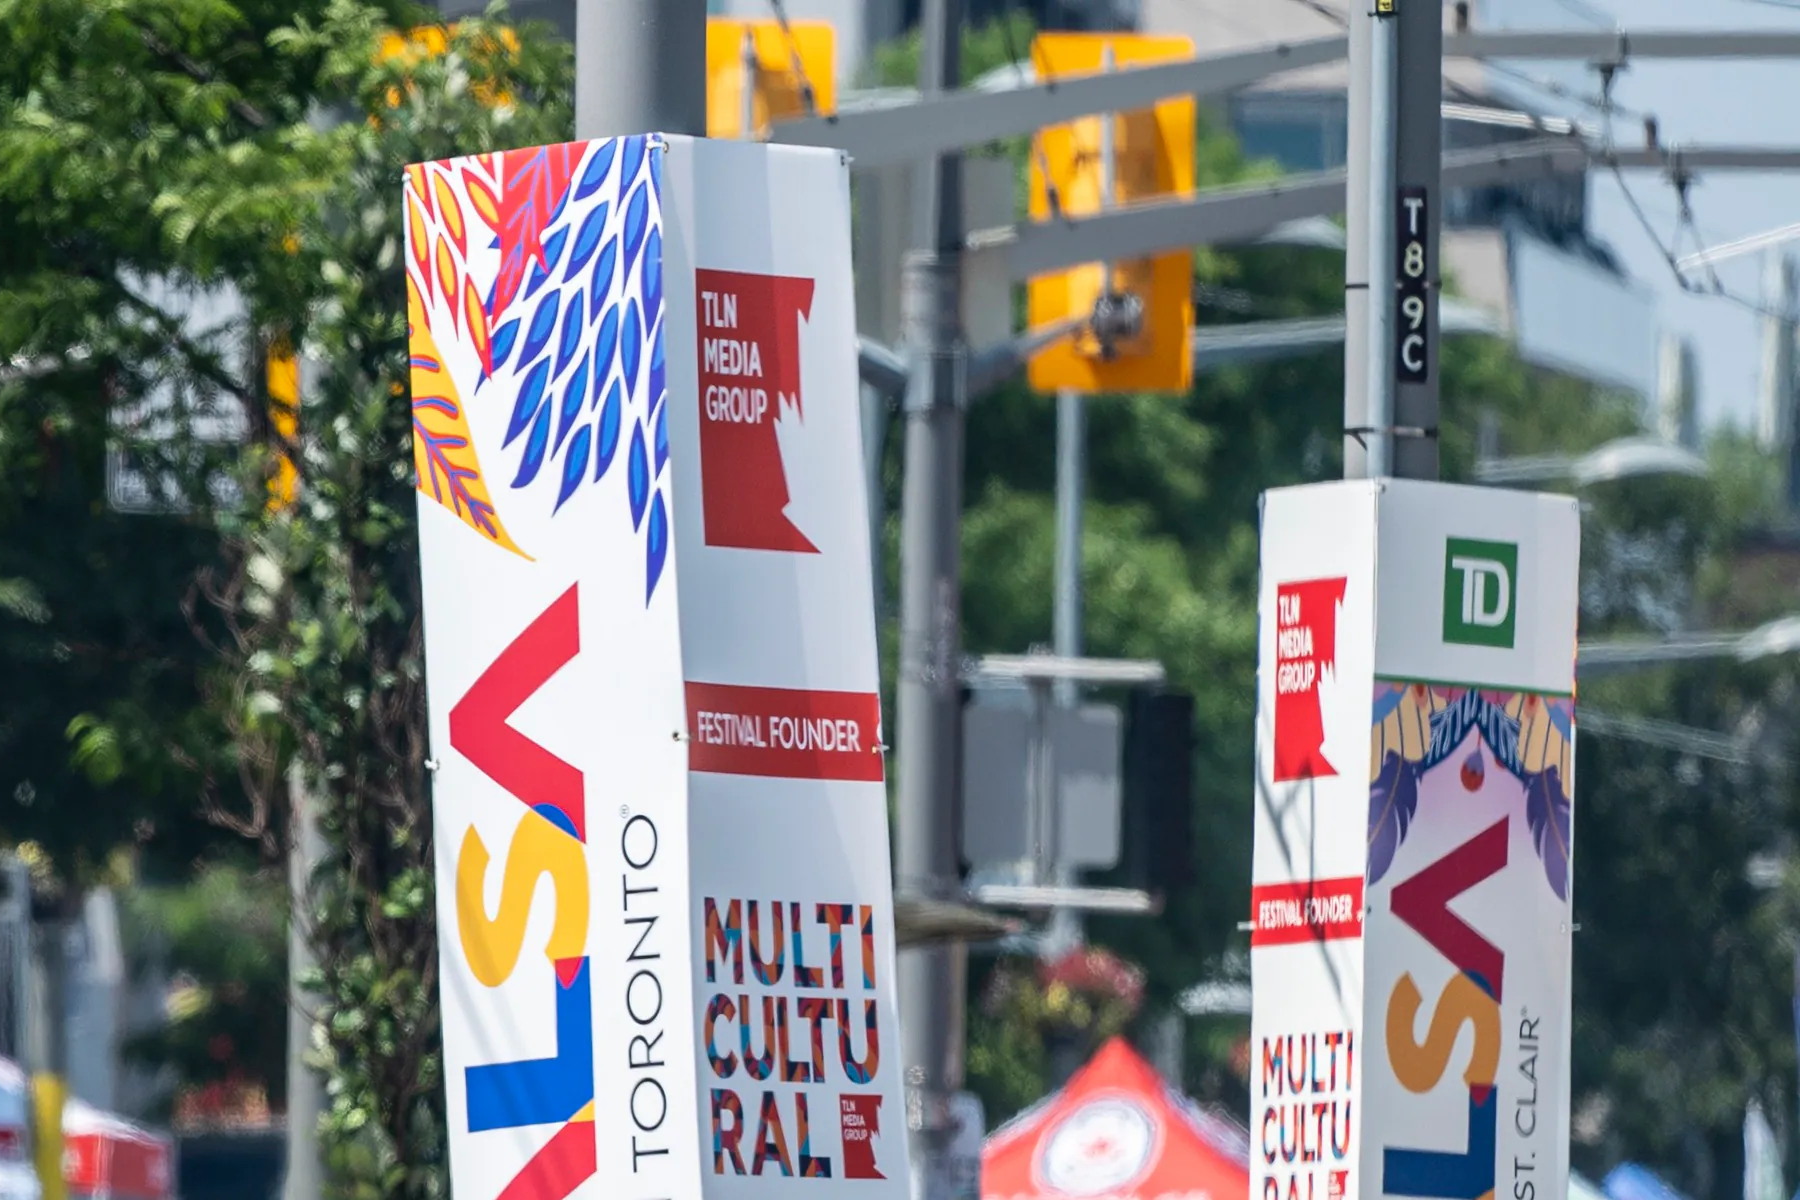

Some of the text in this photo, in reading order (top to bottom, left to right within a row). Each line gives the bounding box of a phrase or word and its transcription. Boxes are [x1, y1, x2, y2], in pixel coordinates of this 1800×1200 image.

[701, 290, 738, 329] TLN
[703, 337, 763, 378] MEDIA
[705, 384, 768, 424] GROUP
[1278, 593, 1301, 626] TLN
[1451, 554, 1511, 628] TD
[1278, 625, 1314, 660] MEDIA
[1277, 660, 1316, 694] GROUP
[697, 711, 862, 752] FESTIVAL FOUNDER
[1258, 893, 1353, 930] FESTIVAL FOUNDER
[703, 896, 877, 990] MULTI
[703, 992, 881, 1085] CULTU
[1262, 1028, 1354, 1098] MULTI
[709, 1087, 832, 1179] RAL
[842, 1114, 866, 1127] MEDIA
[843, 1128, 869, 1141] GROUP
[1262, 1099, 1352, 1165] CULTU
